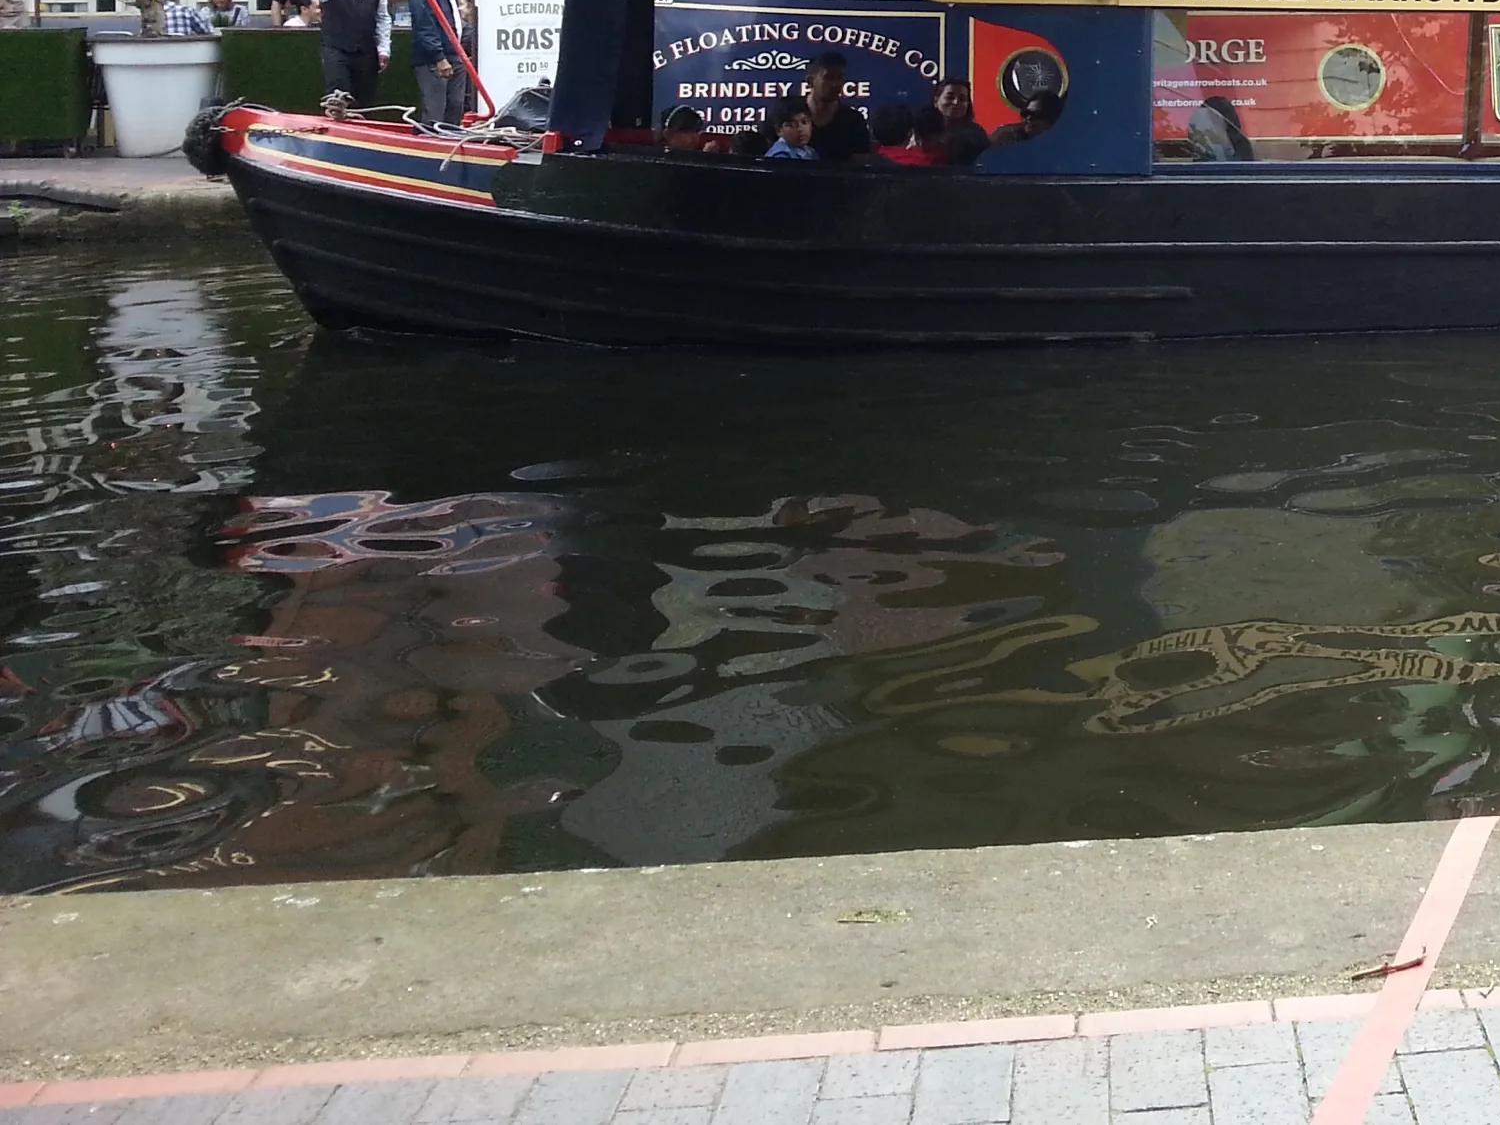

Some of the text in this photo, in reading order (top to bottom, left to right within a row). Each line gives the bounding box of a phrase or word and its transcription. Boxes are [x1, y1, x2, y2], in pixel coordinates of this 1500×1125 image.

[669, 23, 799, 60] FLOATING
[807, 24, 900, 58] COFFEE
[904, 50, 939, 85] CO.
[679, 81, 870, 98] BRINDLEY PCE
[720, 106, 766, 122] 0121
